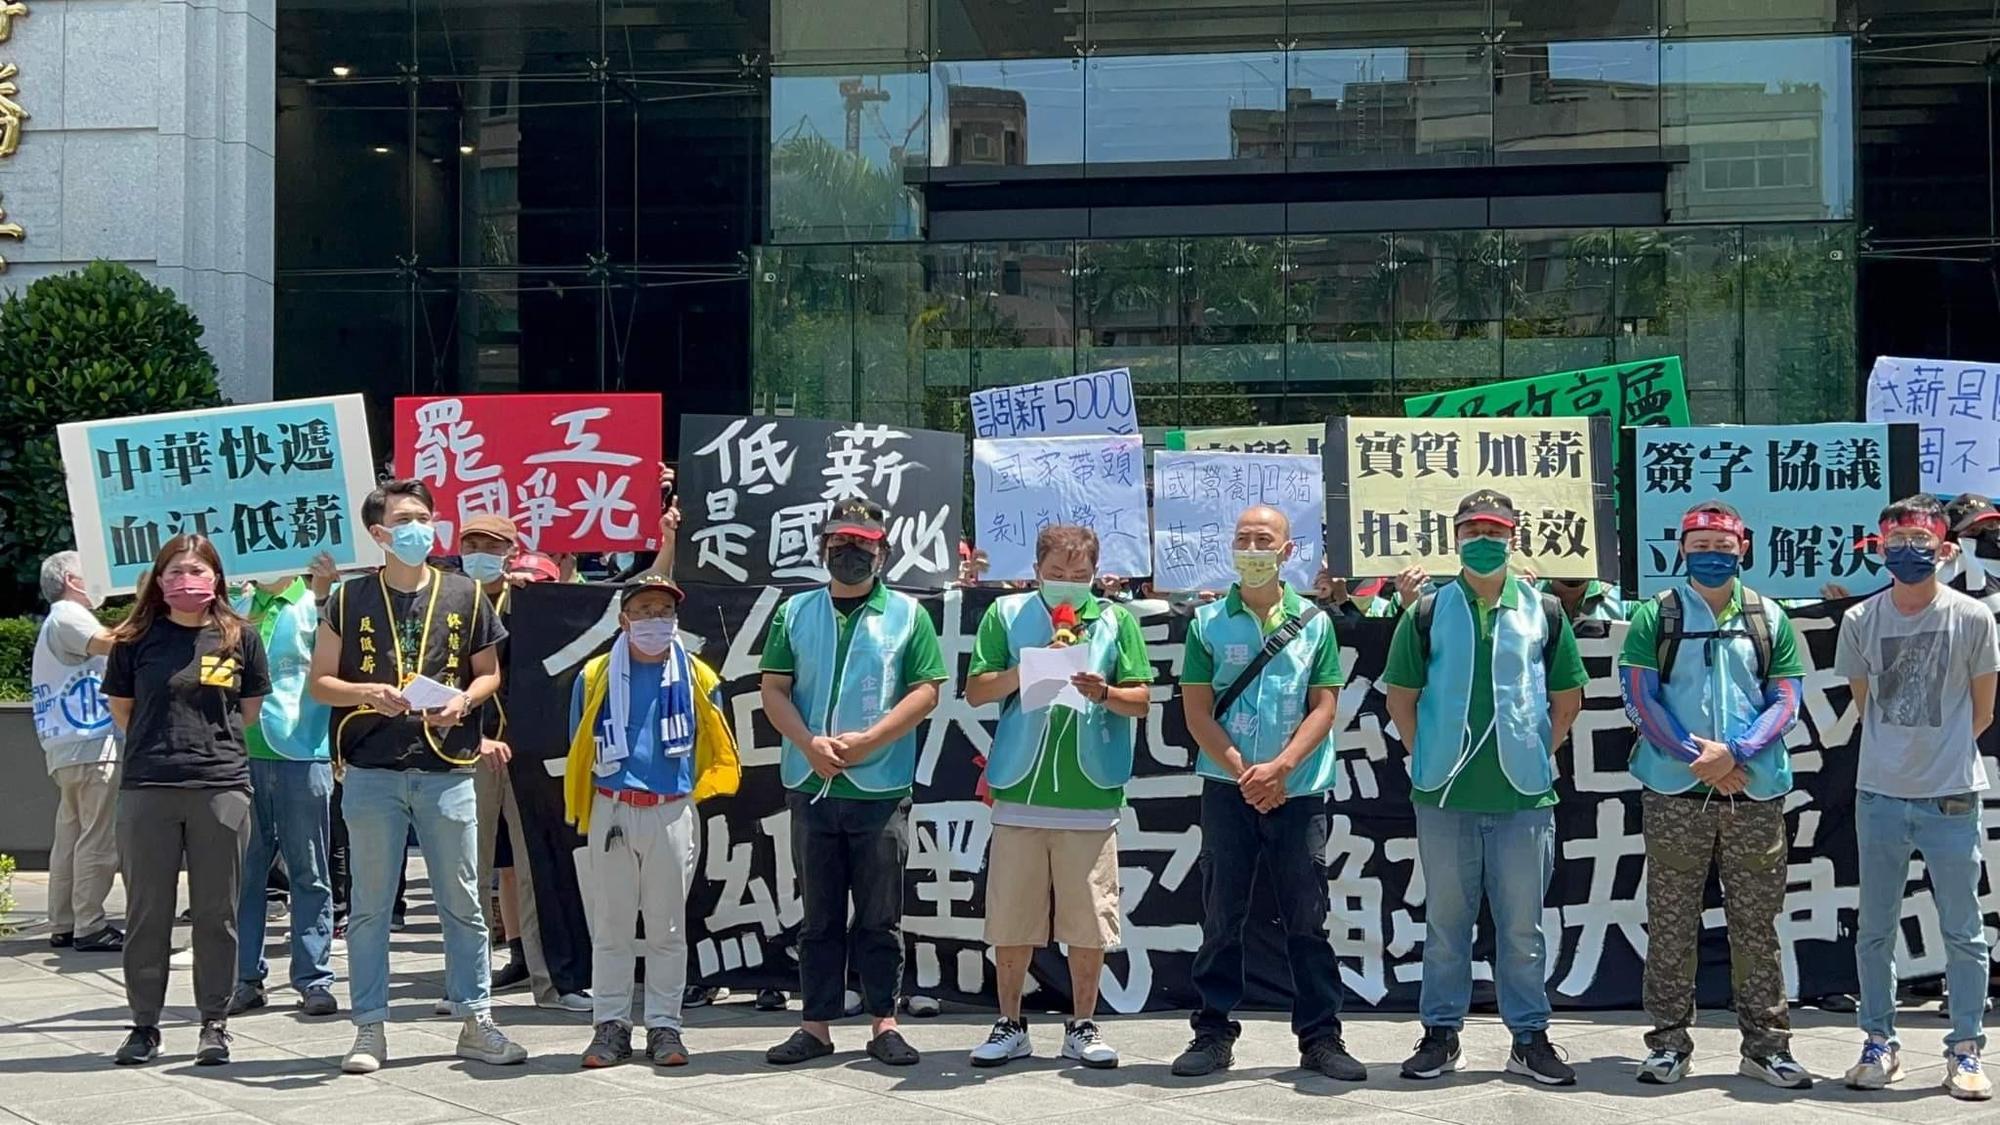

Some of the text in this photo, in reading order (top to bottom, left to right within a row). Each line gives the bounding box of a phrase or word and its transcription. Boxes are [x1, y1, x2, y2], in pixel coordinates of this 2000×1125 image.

[97, 417, 335, 491] 中華快遞
[693, 418, 931, 505] 低薪
[990, 445, 1133, 494] 國家帶頭
[1355, 430, 1586, 479] 實質 加薪
[1643, 438, 1883, 494] 簽字 協議
[433, 467, 643, 551] 國爭光
[1162, 460, 1311, 506] 國營養肥貓
[1769, 525, 1886, 578] 解決
